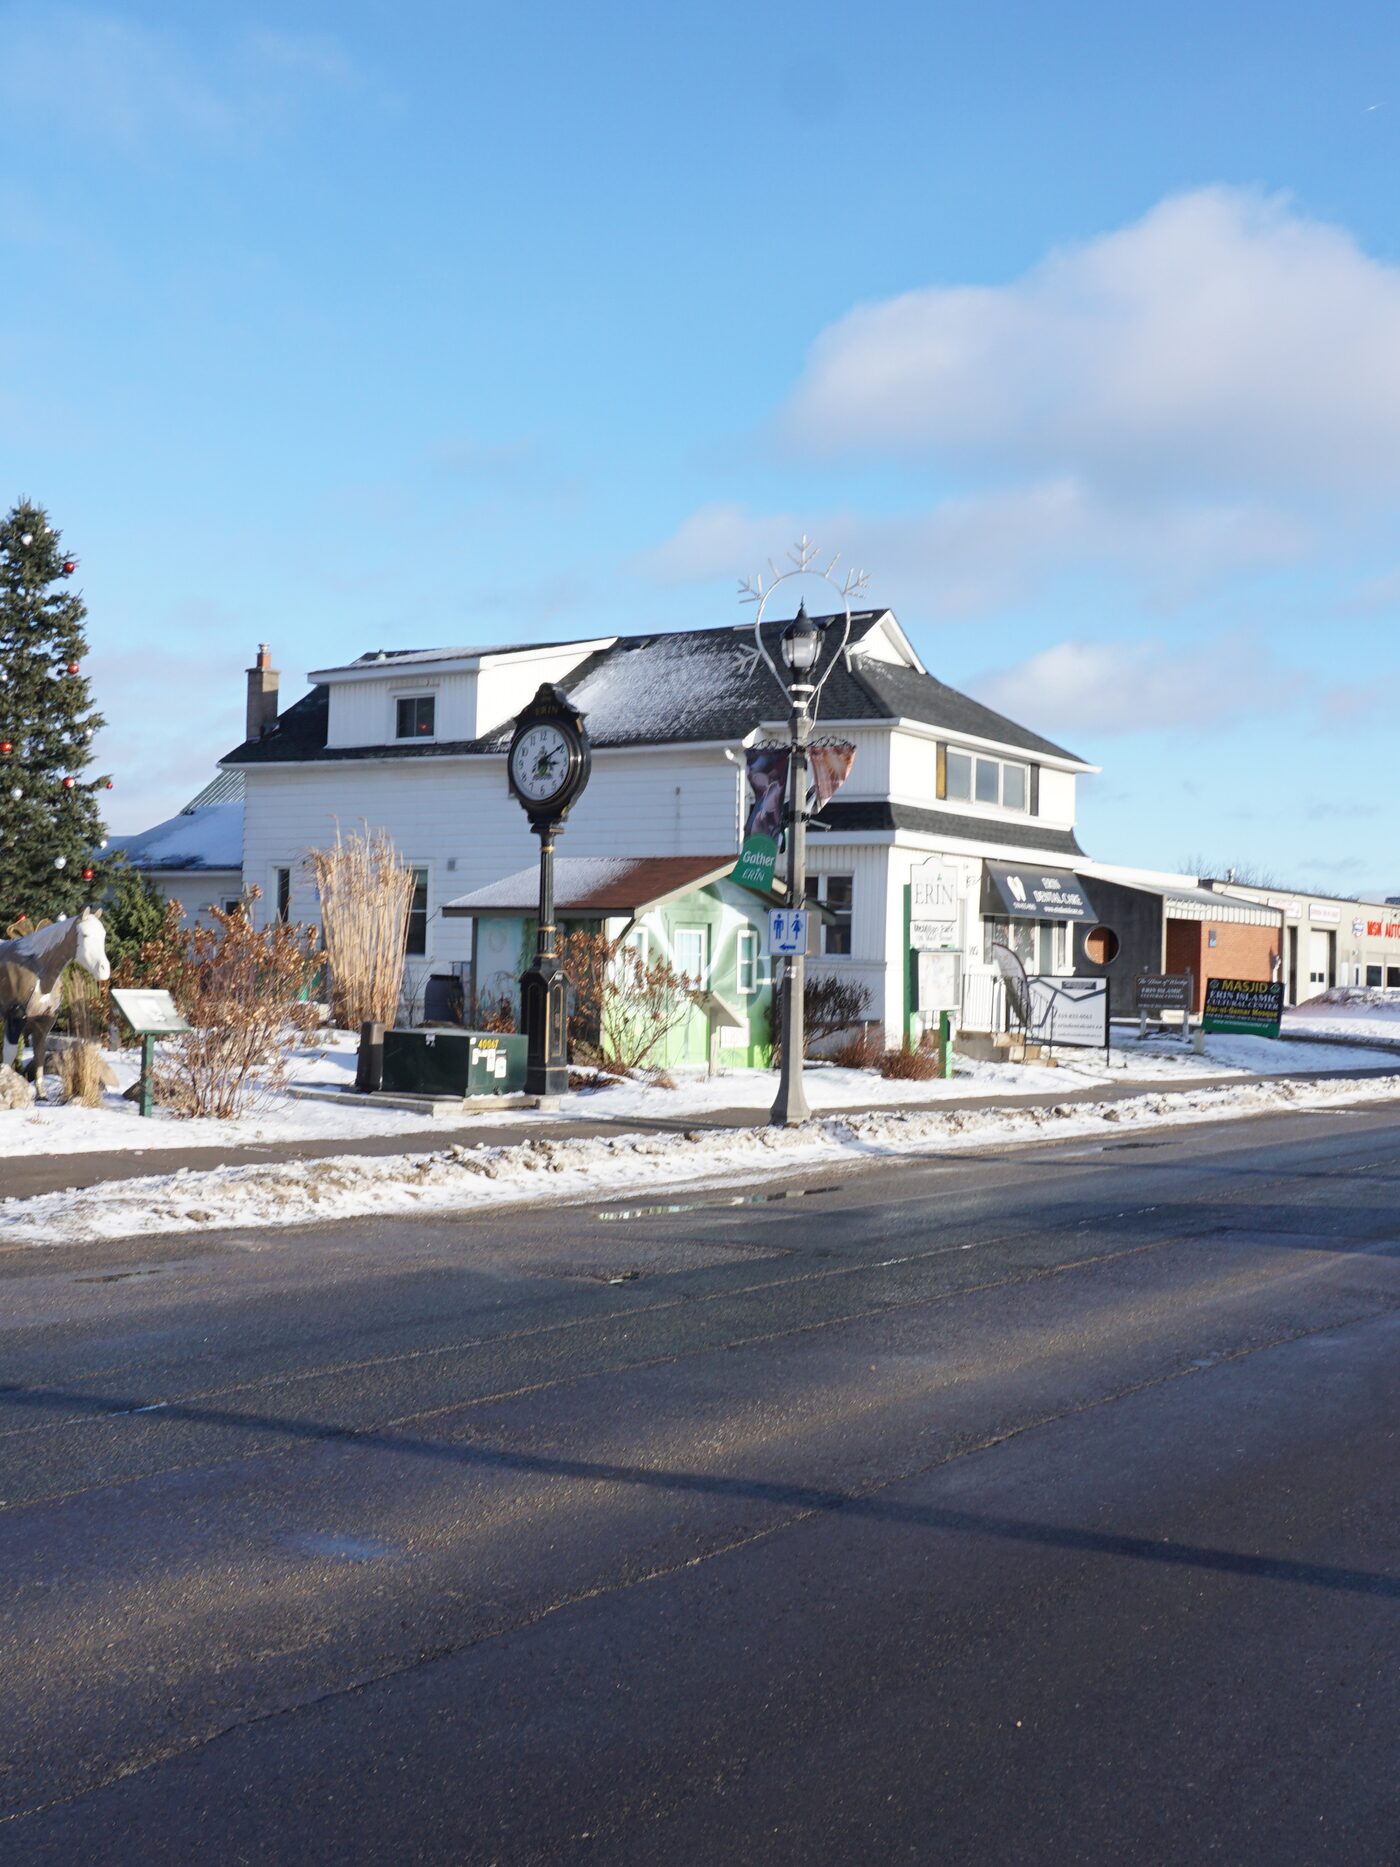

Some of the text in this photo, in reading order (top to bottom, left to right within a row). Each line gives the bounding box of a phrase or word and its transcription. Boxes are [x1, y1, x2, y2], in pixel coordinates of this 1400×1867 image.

[530, 735, 536, 746] 11
[539, 730, 547, 741] 12
[521, 746, 529, 757] 10
[528, 782, 534, 792] 7
[742, 850, 775, 867] Gather
[742, 867, 766, 882] ERIN
[914, 882, 954, 905] ERIN
[1221, 979, 1268, 993] MASJID
[1209, 990, 1279, 1003] ERIN ISLAMIC
